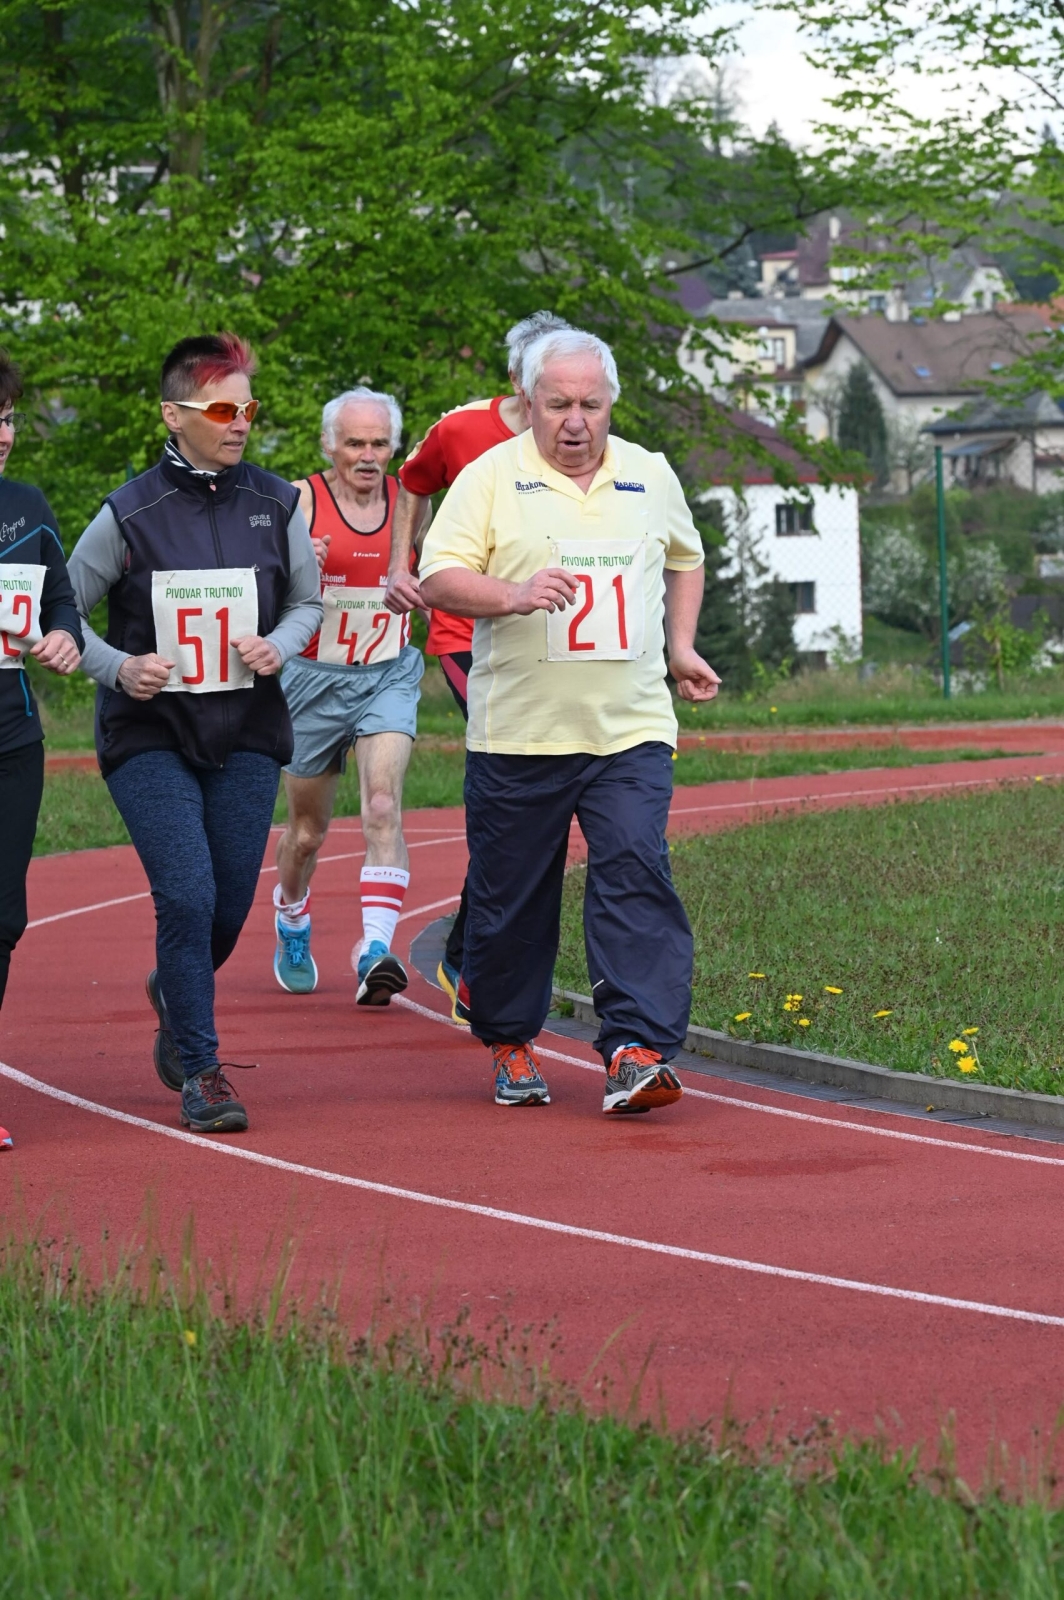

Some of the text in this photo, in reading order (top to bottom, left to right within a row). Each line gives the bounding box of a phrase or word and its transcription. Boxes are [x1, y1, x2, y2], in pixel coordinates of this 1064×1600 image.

[613, 480, 645, 490] MARATON
[250, 520, 272, 528] SPEED
[561, 555, 595, 567] PIVOVAR
[165, 587, 243, 598] PIVOVAR TRUTNOV
[336, 600, 388, 611] PIVOVAR TRUT
[568, 574, 628, 651] 21
[0, 594, 32, 657] 2
[337, 612, 391, 665] 42
[177, 607, 229, 685] 51
